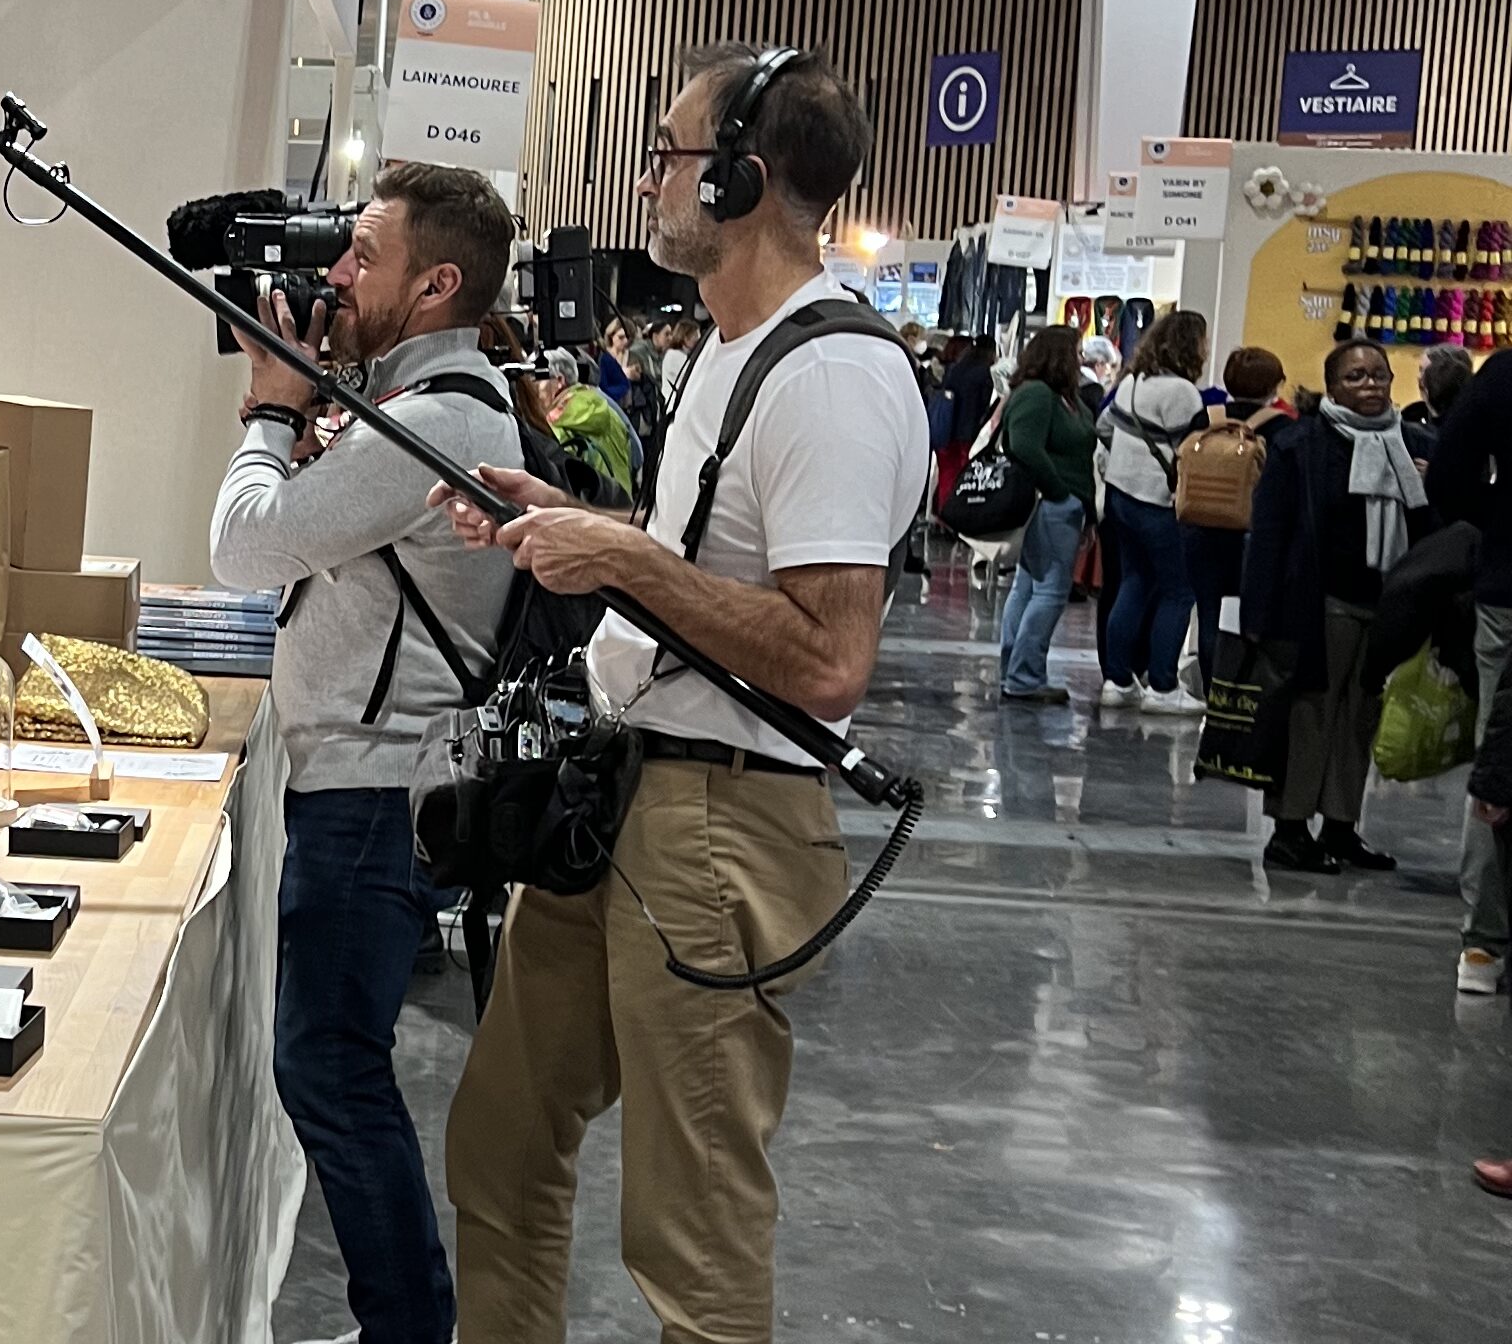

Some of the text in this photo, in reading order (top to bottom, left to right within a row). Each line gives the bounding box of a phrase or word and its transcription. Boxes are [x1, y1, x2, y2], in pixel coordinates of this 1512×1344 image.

[402, 69, 521, 94] LAIN'AMOUREE
[1299, 96, 1398, 114] VESTIAIRE
[427, 125, 481, 144] D 046
[1164, 216, 1197, 227] D 041
